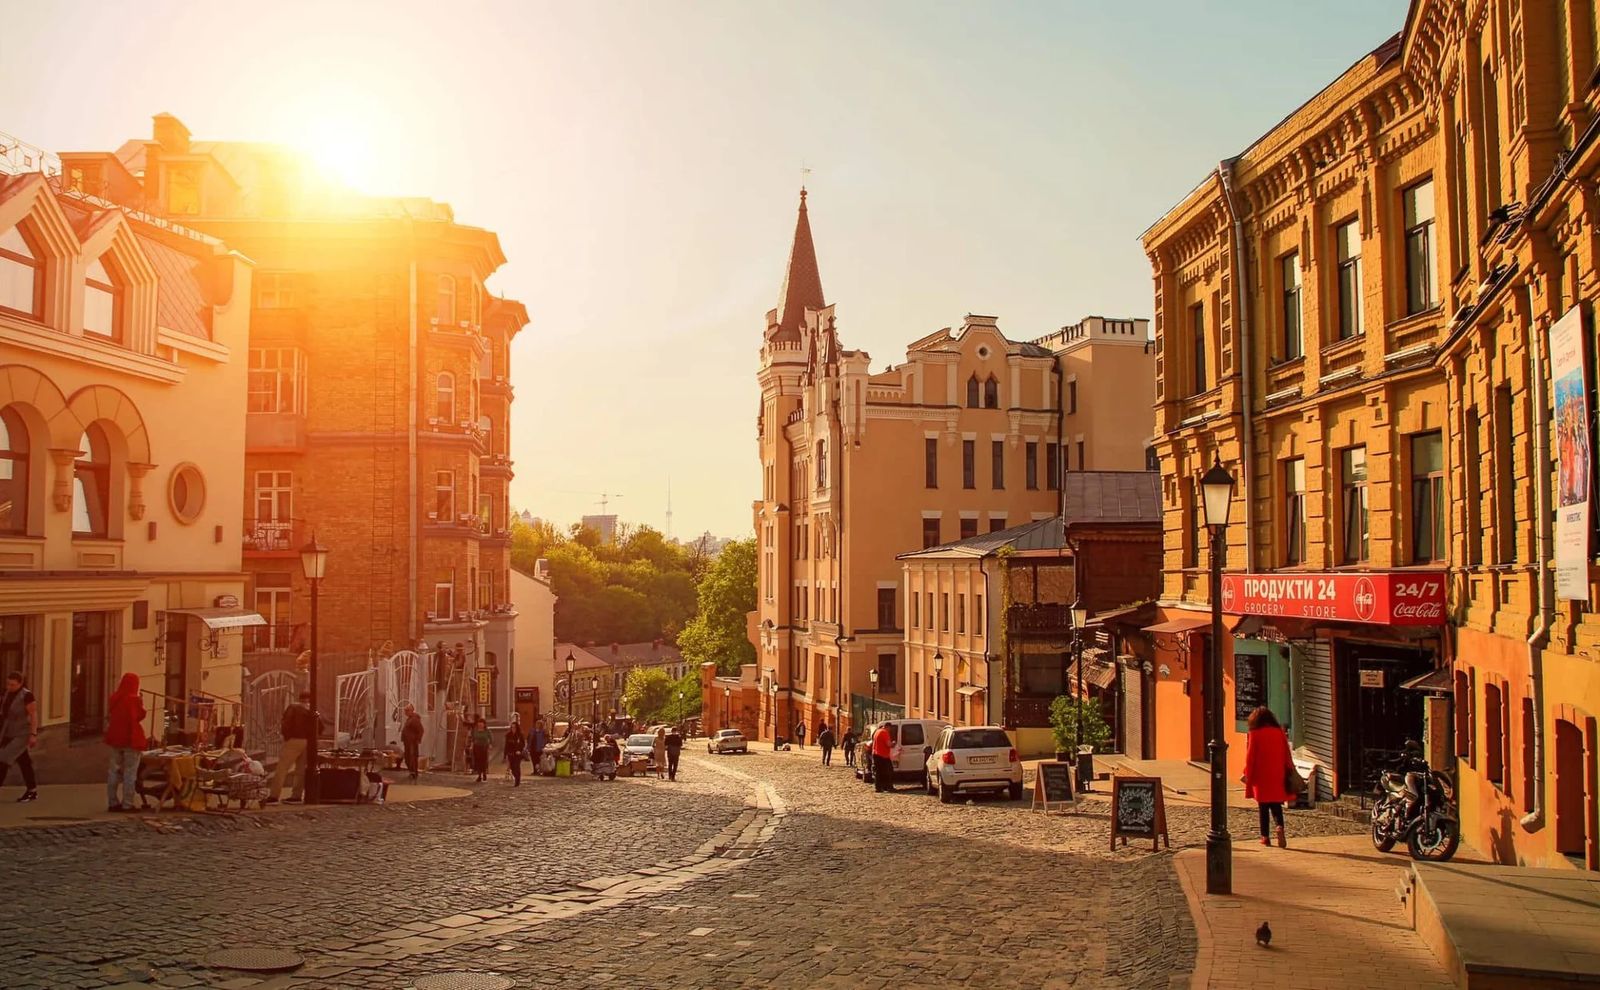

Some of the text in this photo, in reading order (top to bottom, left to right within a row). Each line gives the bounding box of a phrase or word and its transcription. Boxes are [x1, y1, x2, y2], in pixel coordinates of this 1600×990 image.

[1244, 579, 1313, 601] ПРОДУКТИ
[1318, 579, 1336, 600] 24
[1395, 581, 1439, 598] 24/7
[1244, 602, 1337, 618] GROCERY STORE
[1393, 602, 1441, 617] Coca-Cola
